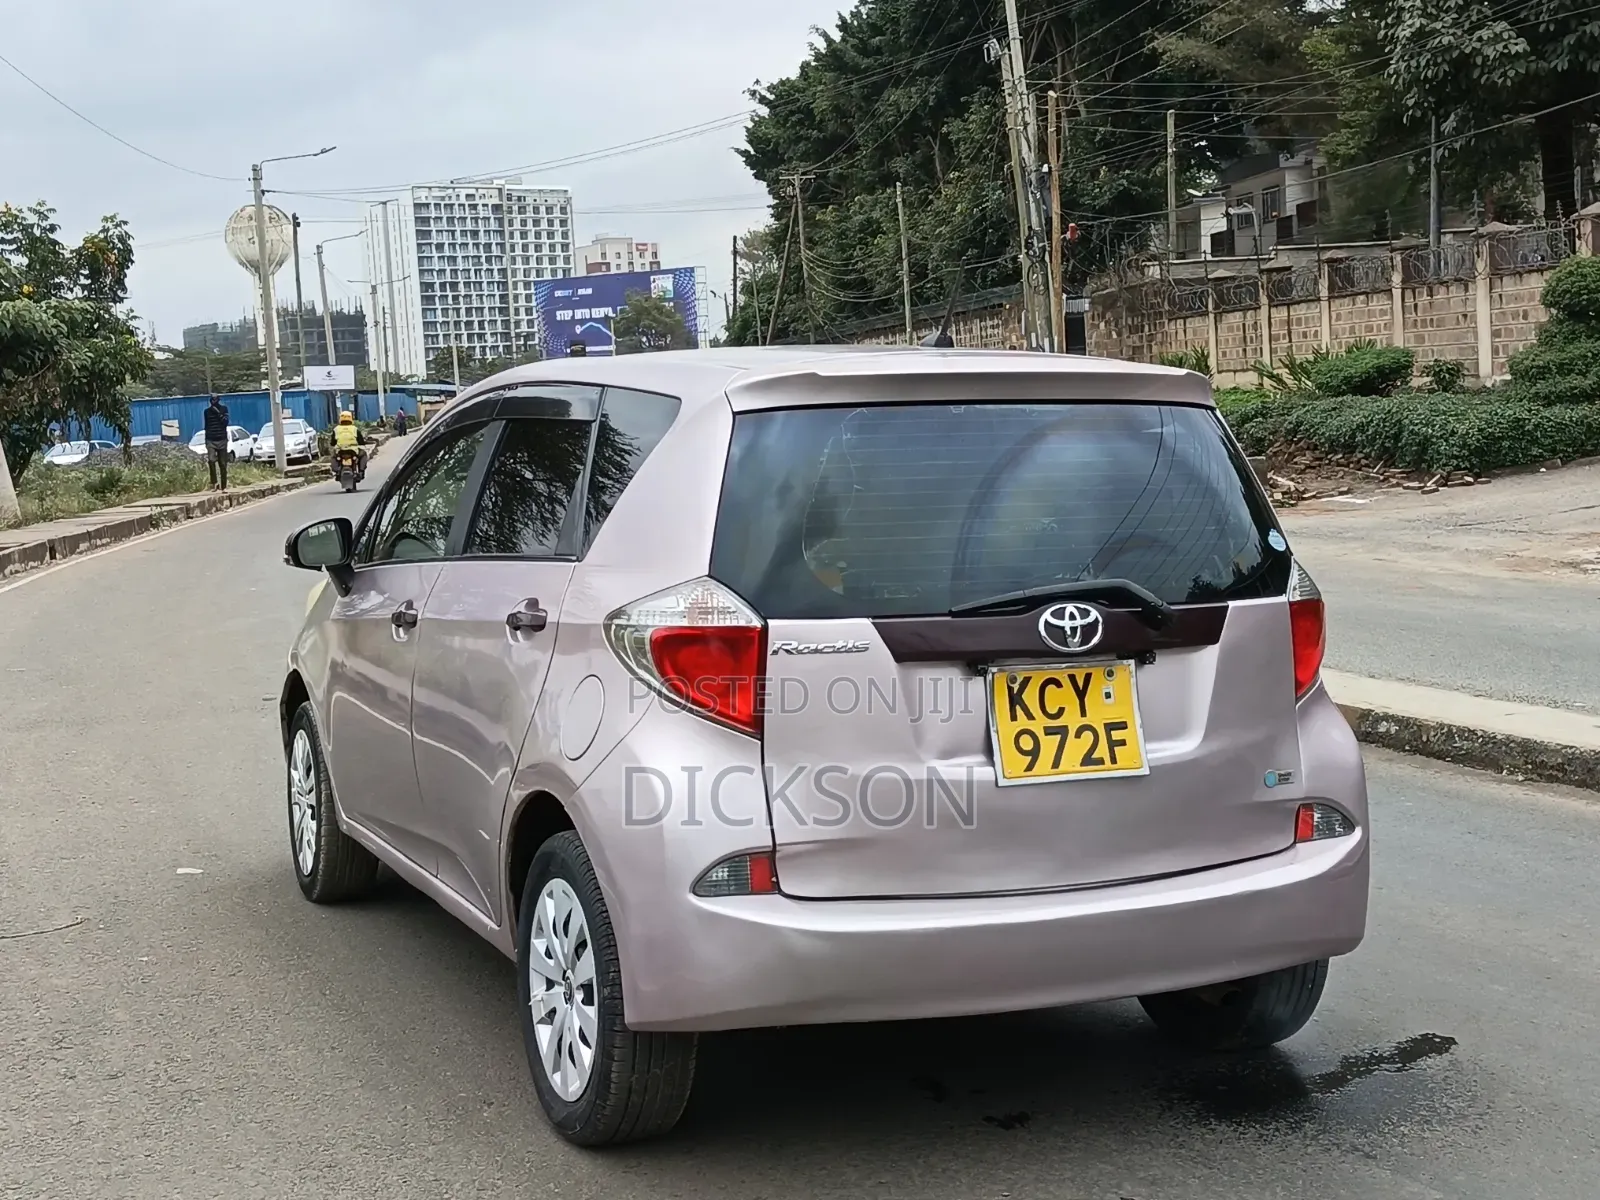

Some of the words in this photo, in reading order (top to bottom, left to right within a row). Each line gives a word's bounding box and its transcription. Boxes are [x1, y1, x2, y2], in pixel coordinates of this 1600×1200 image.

[770, 640, 871, 656] Ractis
[1006, 672, 1093, 722] KCY
[1013, 721, 1129, 773] 972F
